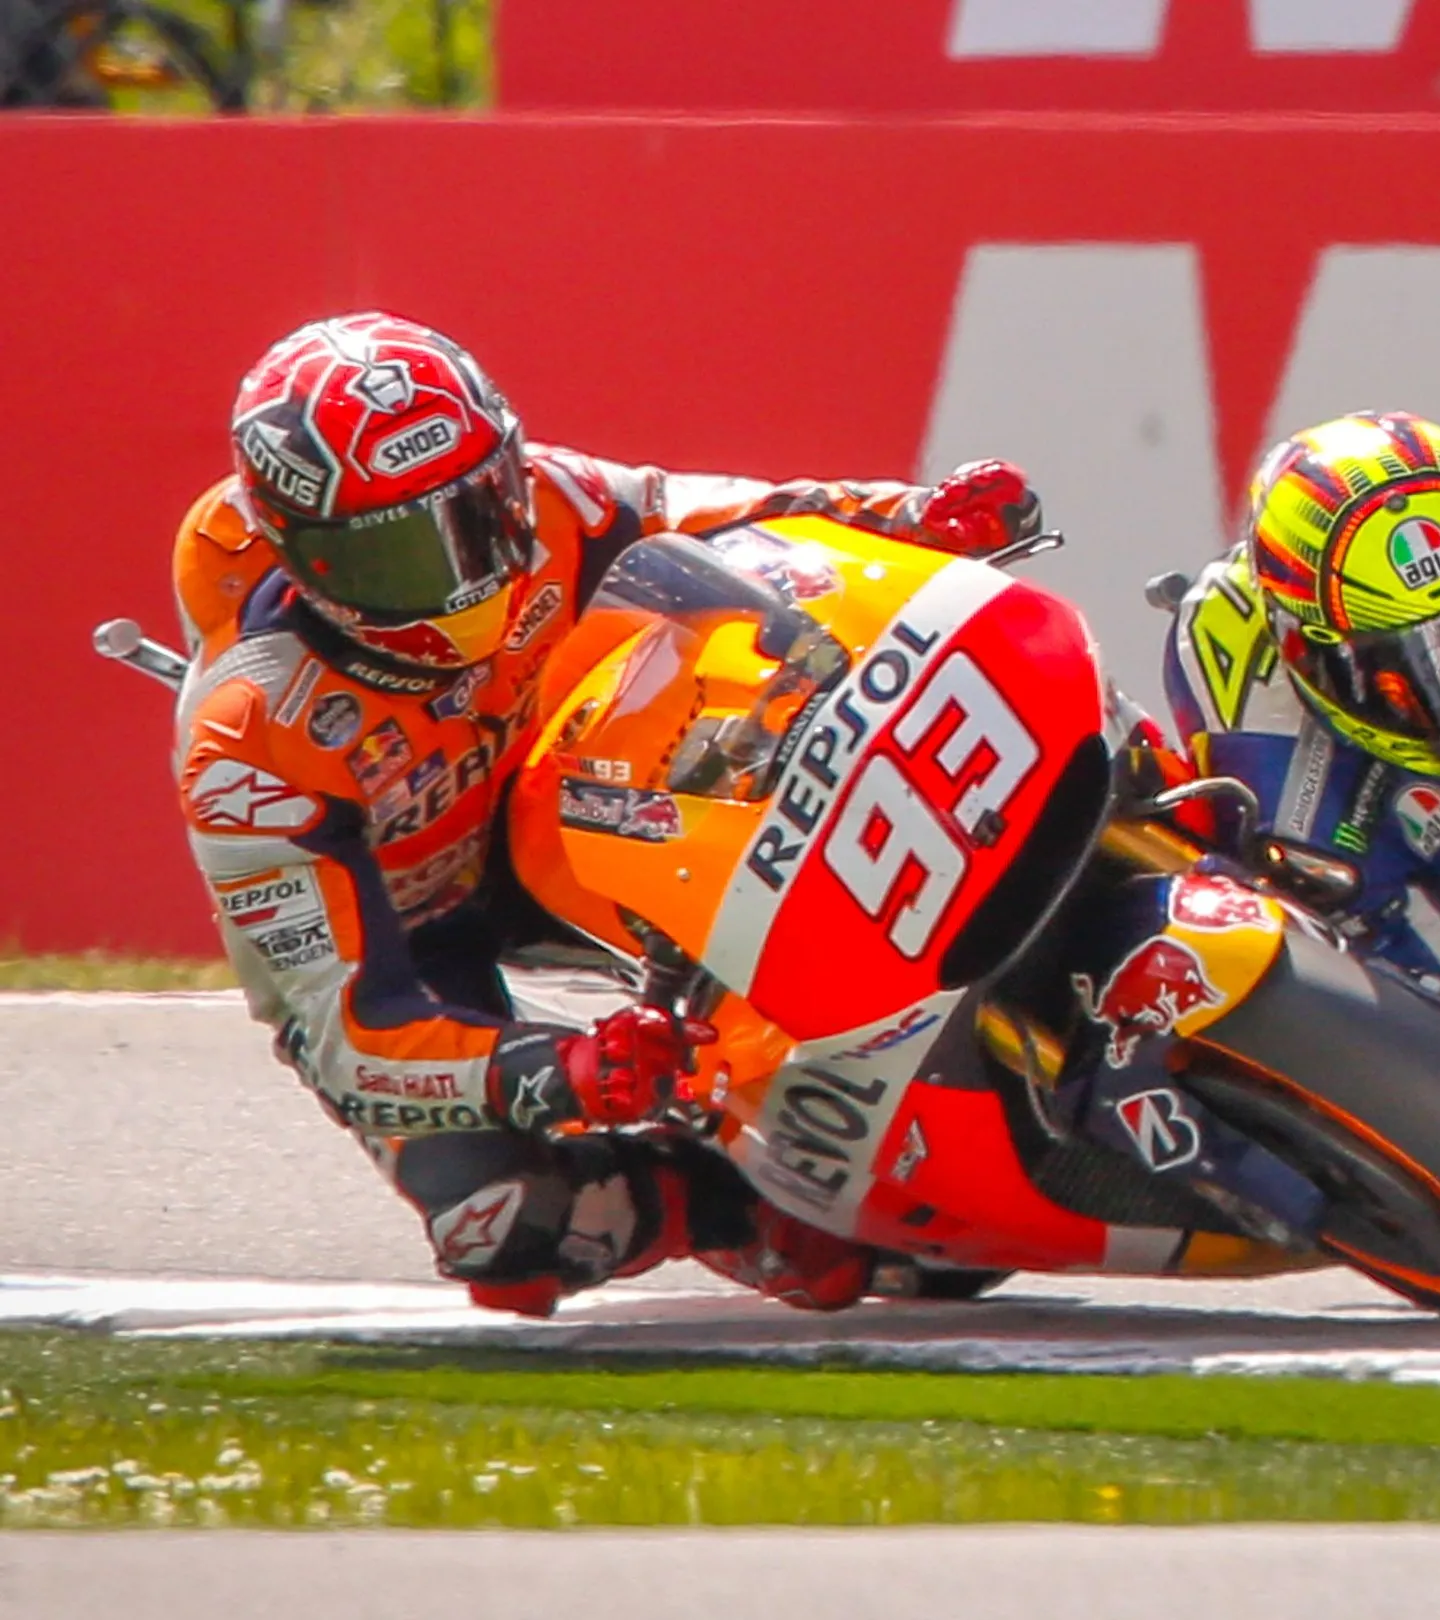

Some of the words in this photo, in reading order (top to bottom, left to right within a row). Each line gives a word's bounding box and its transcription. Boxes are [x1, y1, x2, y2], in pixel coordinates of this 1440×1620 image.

[381, 421, 450, 469] SHOEI
[417, 484, 460, 510] YOU
[346, 661, 438, 692] REPSOL
[594, 760, 632, 782] 93
[747, 620, 941, 893] REPSOL
[822, 649, 1043, 960] 93
[339, 1092, 492, 1129] REPSO
